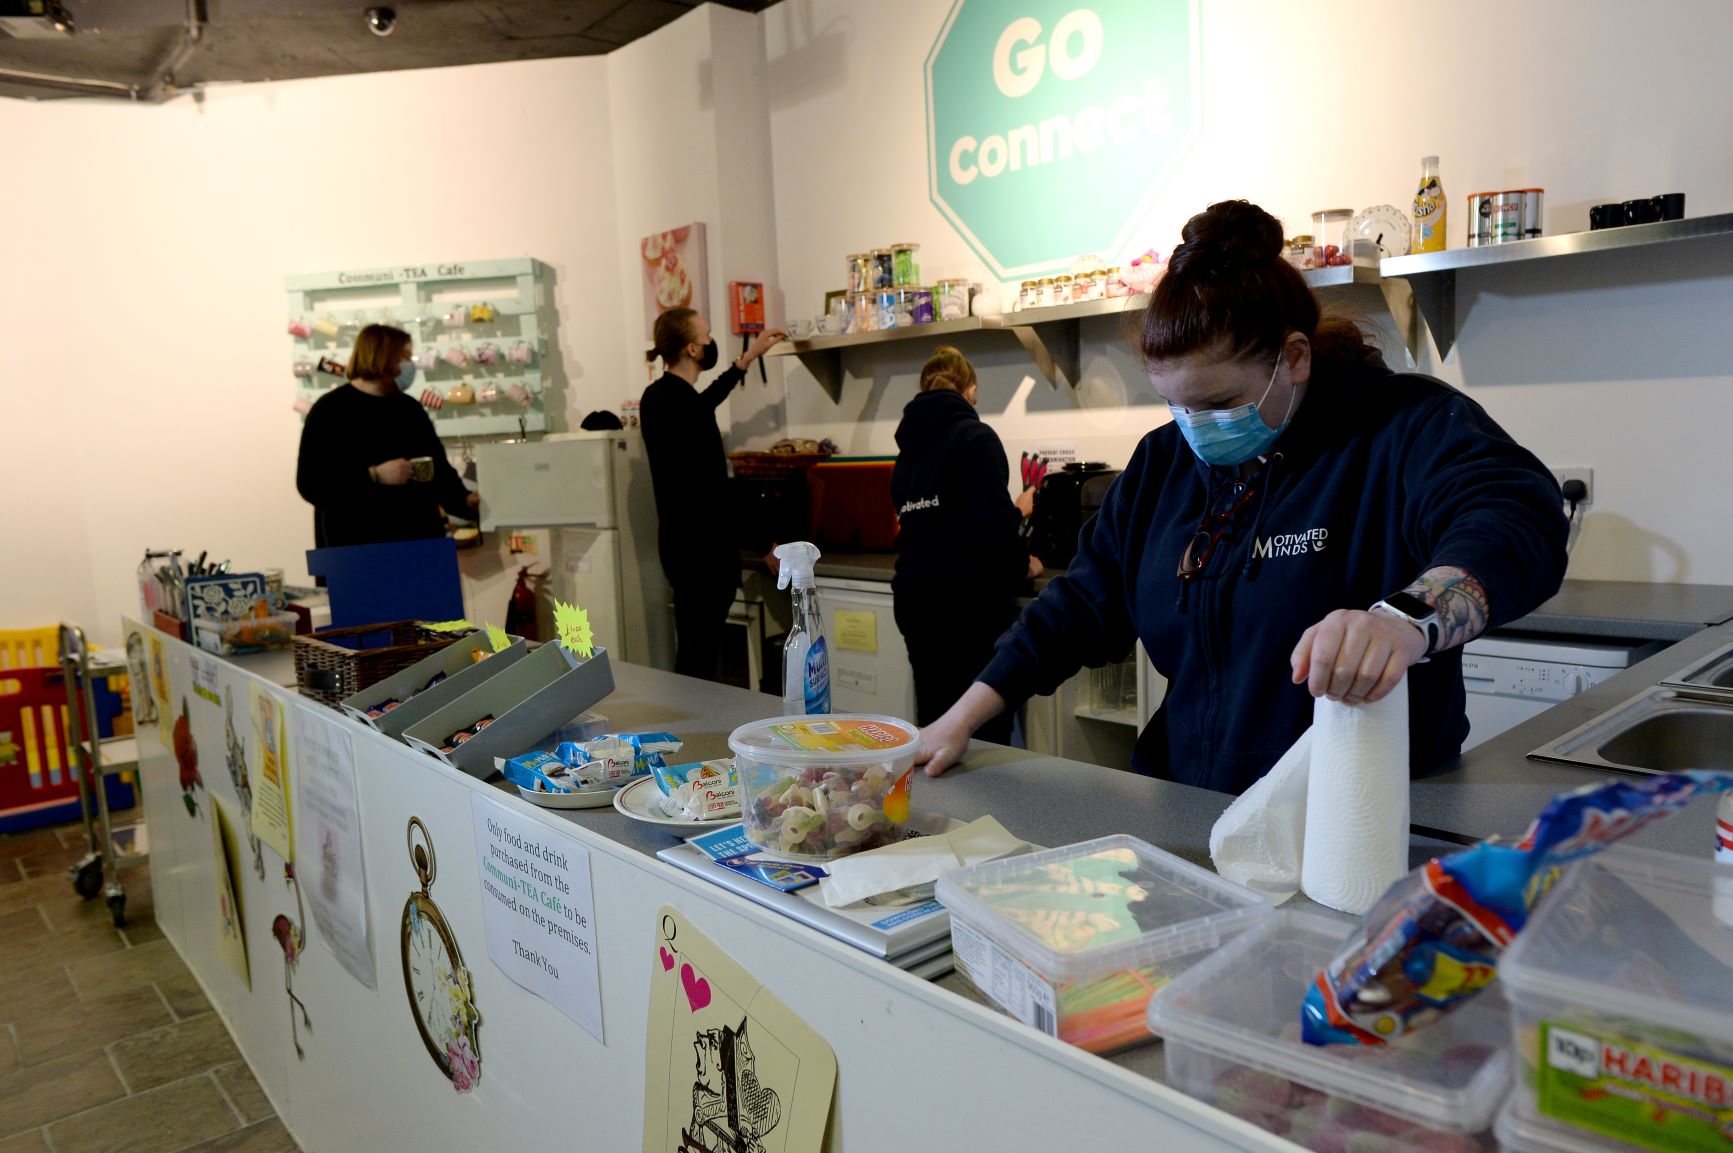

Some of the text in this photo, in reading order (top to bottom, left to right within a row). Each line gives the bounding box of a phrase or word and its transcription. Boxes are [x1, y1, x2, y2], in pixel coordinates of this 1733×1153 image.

[993, 8, 1104, 98] GO
[949, 79, 1173, 185] connect
[437, 264, 465, 277] Cafe
[899, 494, 939, 514] otivated
[692, 779, 722, 792] Balconi
[705, 788, 735, 802] Balconi
[487, 817, 569, 872] Only food and drink
[489, 842, 570, 895] purchased from the
[482, 855, 587, 929] Communi-TEA Café to be
[483, 878, 592, 956] consumed on the premises.
[512, 938, 560, 981] Thank You
[662, 914, 679, 953] Q
[1602, 1045, 1733, 1107] HARIB
